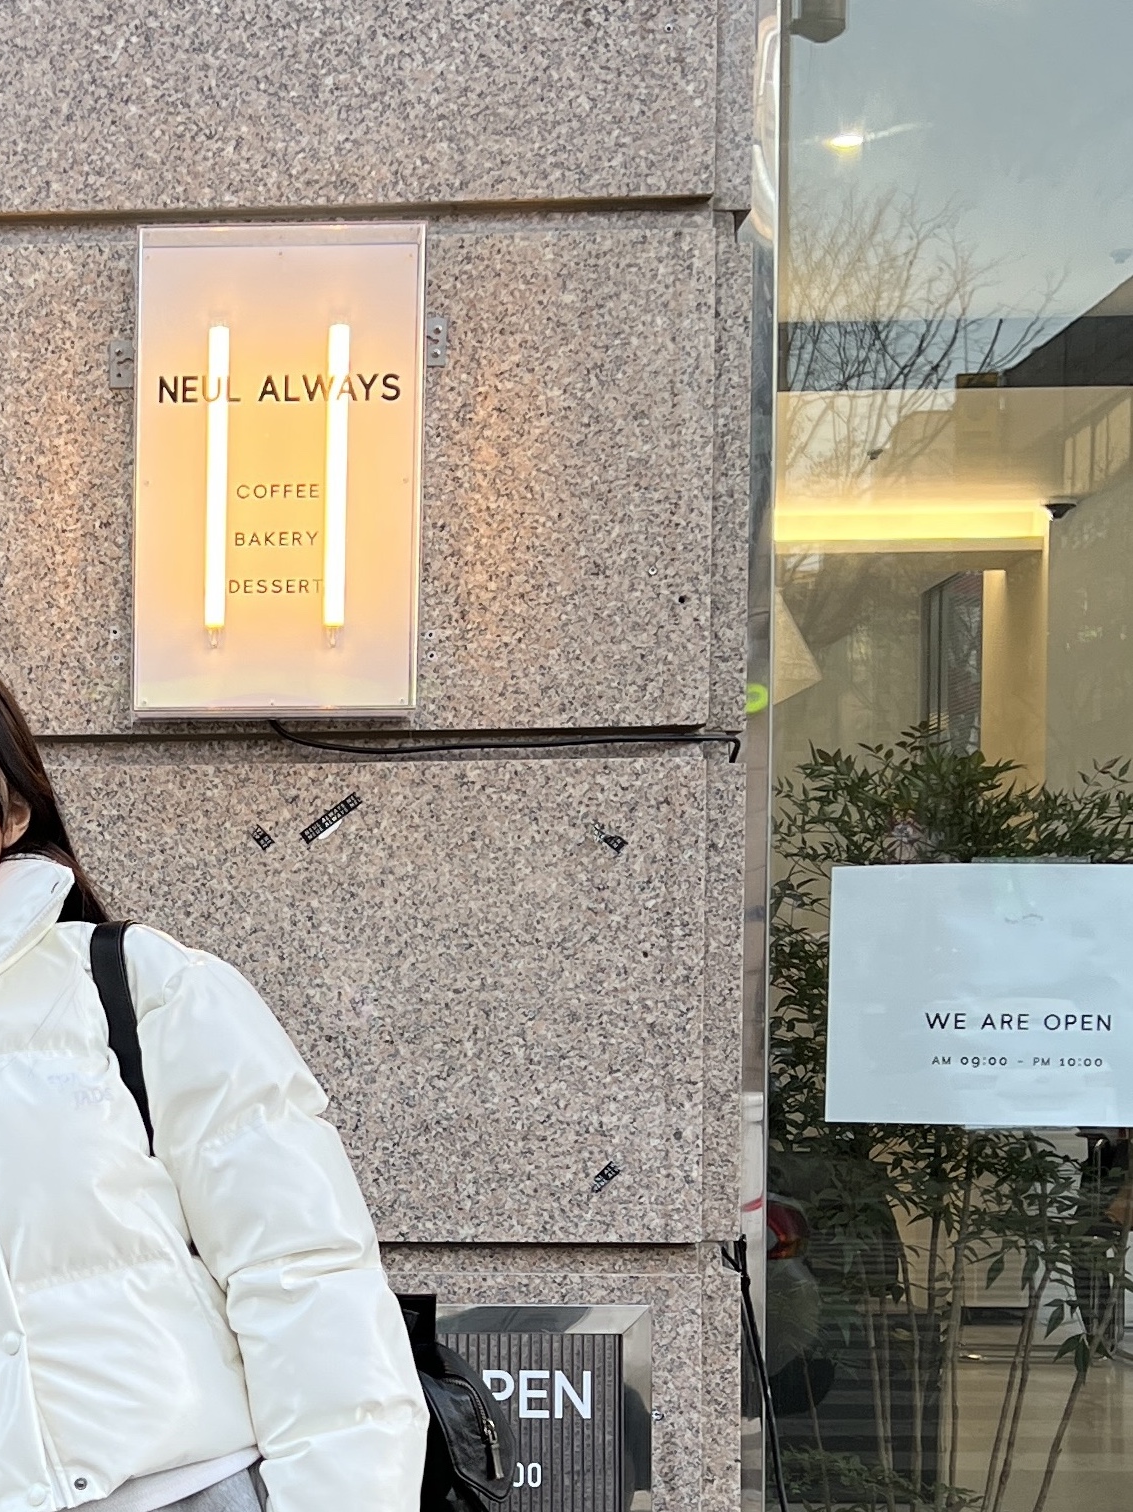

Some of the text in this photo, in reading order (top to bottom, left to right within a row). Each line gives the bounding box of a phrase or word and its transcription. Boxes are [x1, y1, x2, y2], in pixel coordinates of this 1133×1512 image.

[158, 373, 401, 403] NEUL ALWAYS
[236, 484, 320, 500] COFFEE
[234, 531, 319, 547] BAKERY
[228, 579, 324, 594] DESSERT
[925, 1012, 1112, 1031] WE ARE OPEN
[931, 1056, 952, 1065] AM
[960, 1056, 1008, 1068] 09:00
[1032, 1057, 1051, 1066] PM
[1059, 1057, 1104, 1067] 10:00
[482, 1369, 592, 1419] PEN
